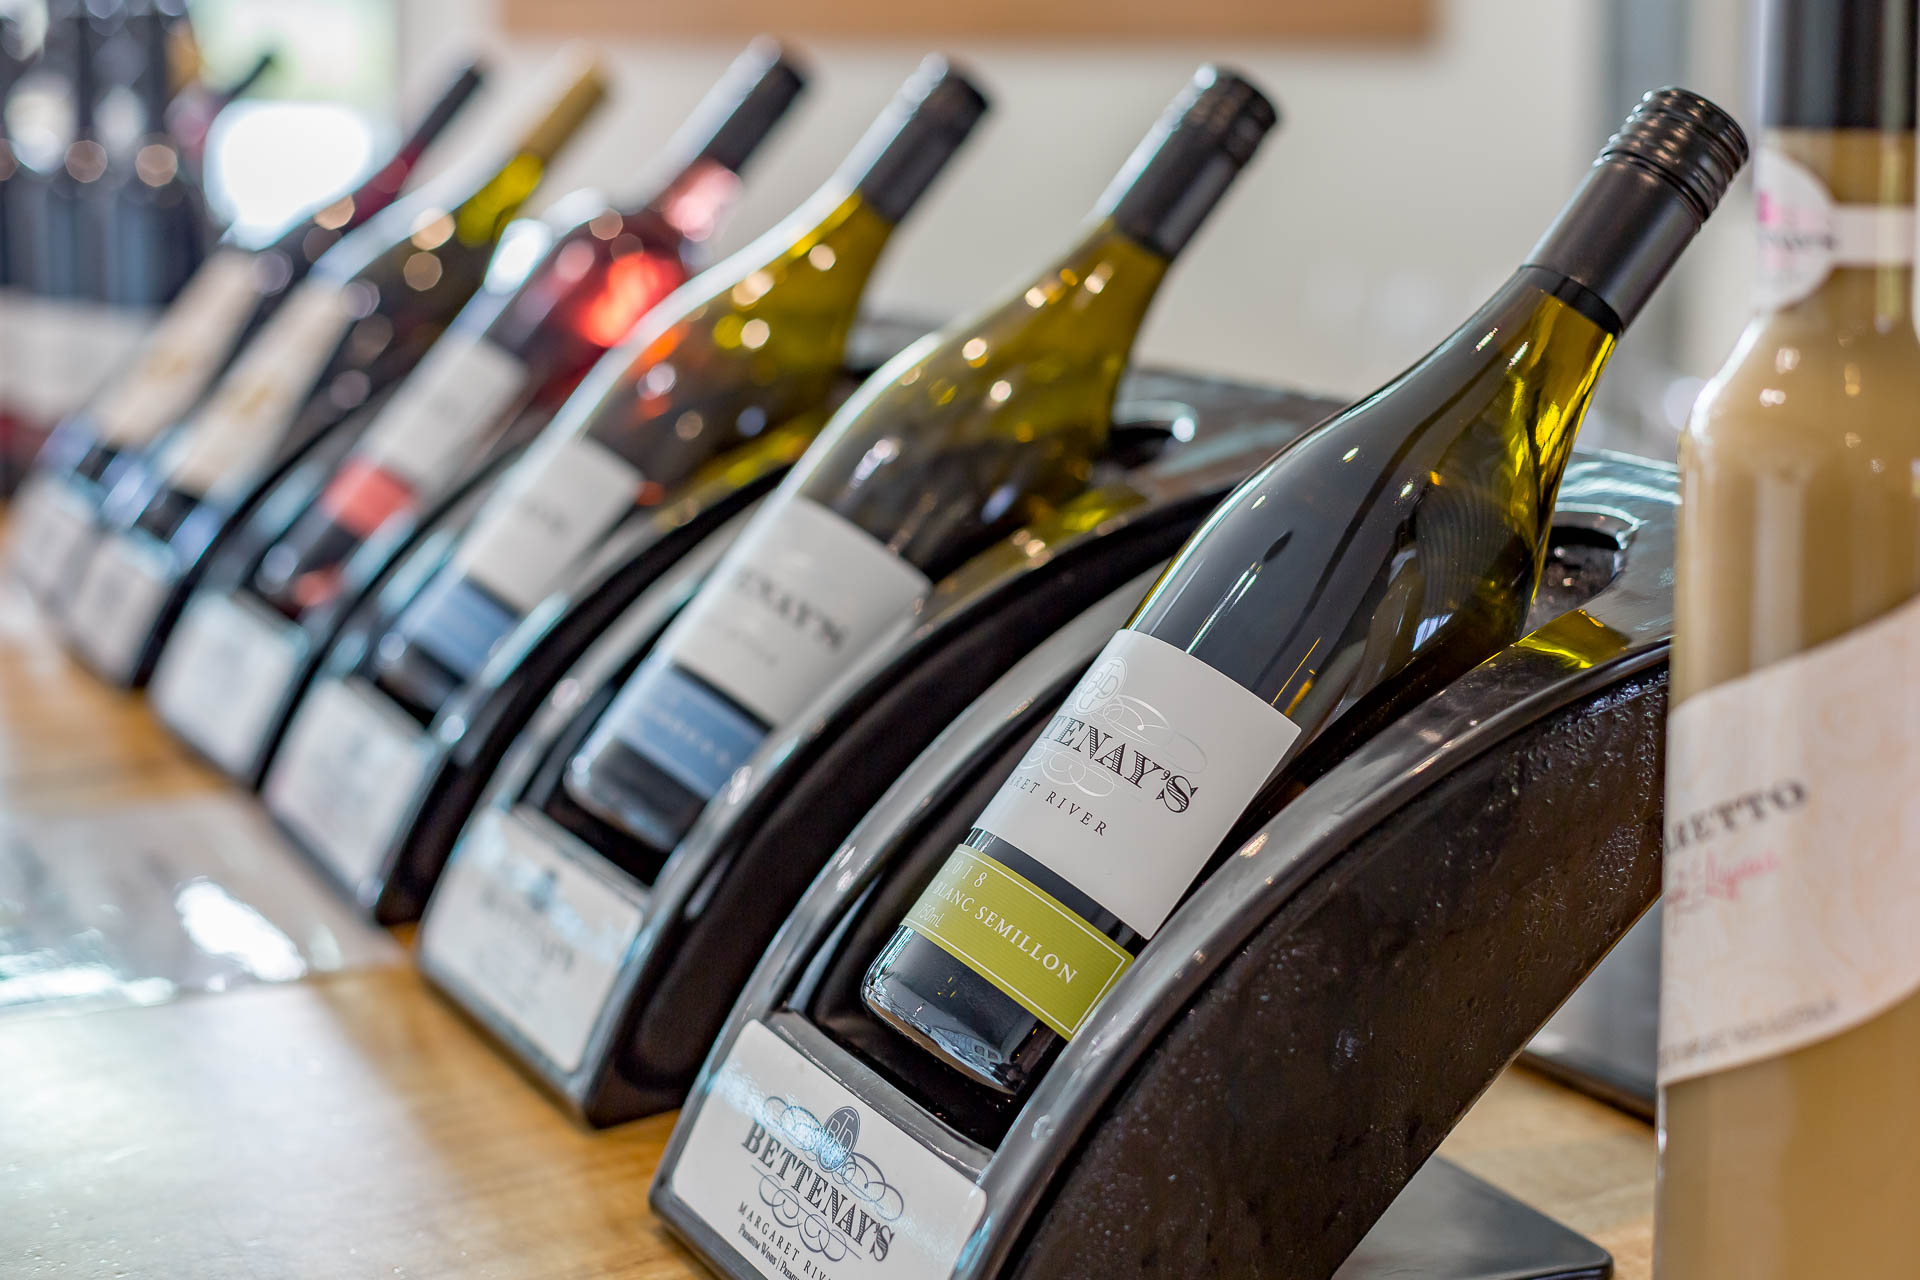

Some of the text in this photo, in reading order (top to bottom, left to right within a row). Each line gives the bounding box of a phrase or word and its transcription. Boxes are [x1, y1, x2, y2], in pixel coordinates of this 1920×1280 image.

[1046, 791, 1107, 836] RIVER
[932, 880, 1078, 984] BLANC SEMILLON
[742, 1119, 895, 1262] BETTENAY'S
[738, 1201, 832, 1280] MARGARET RIV
